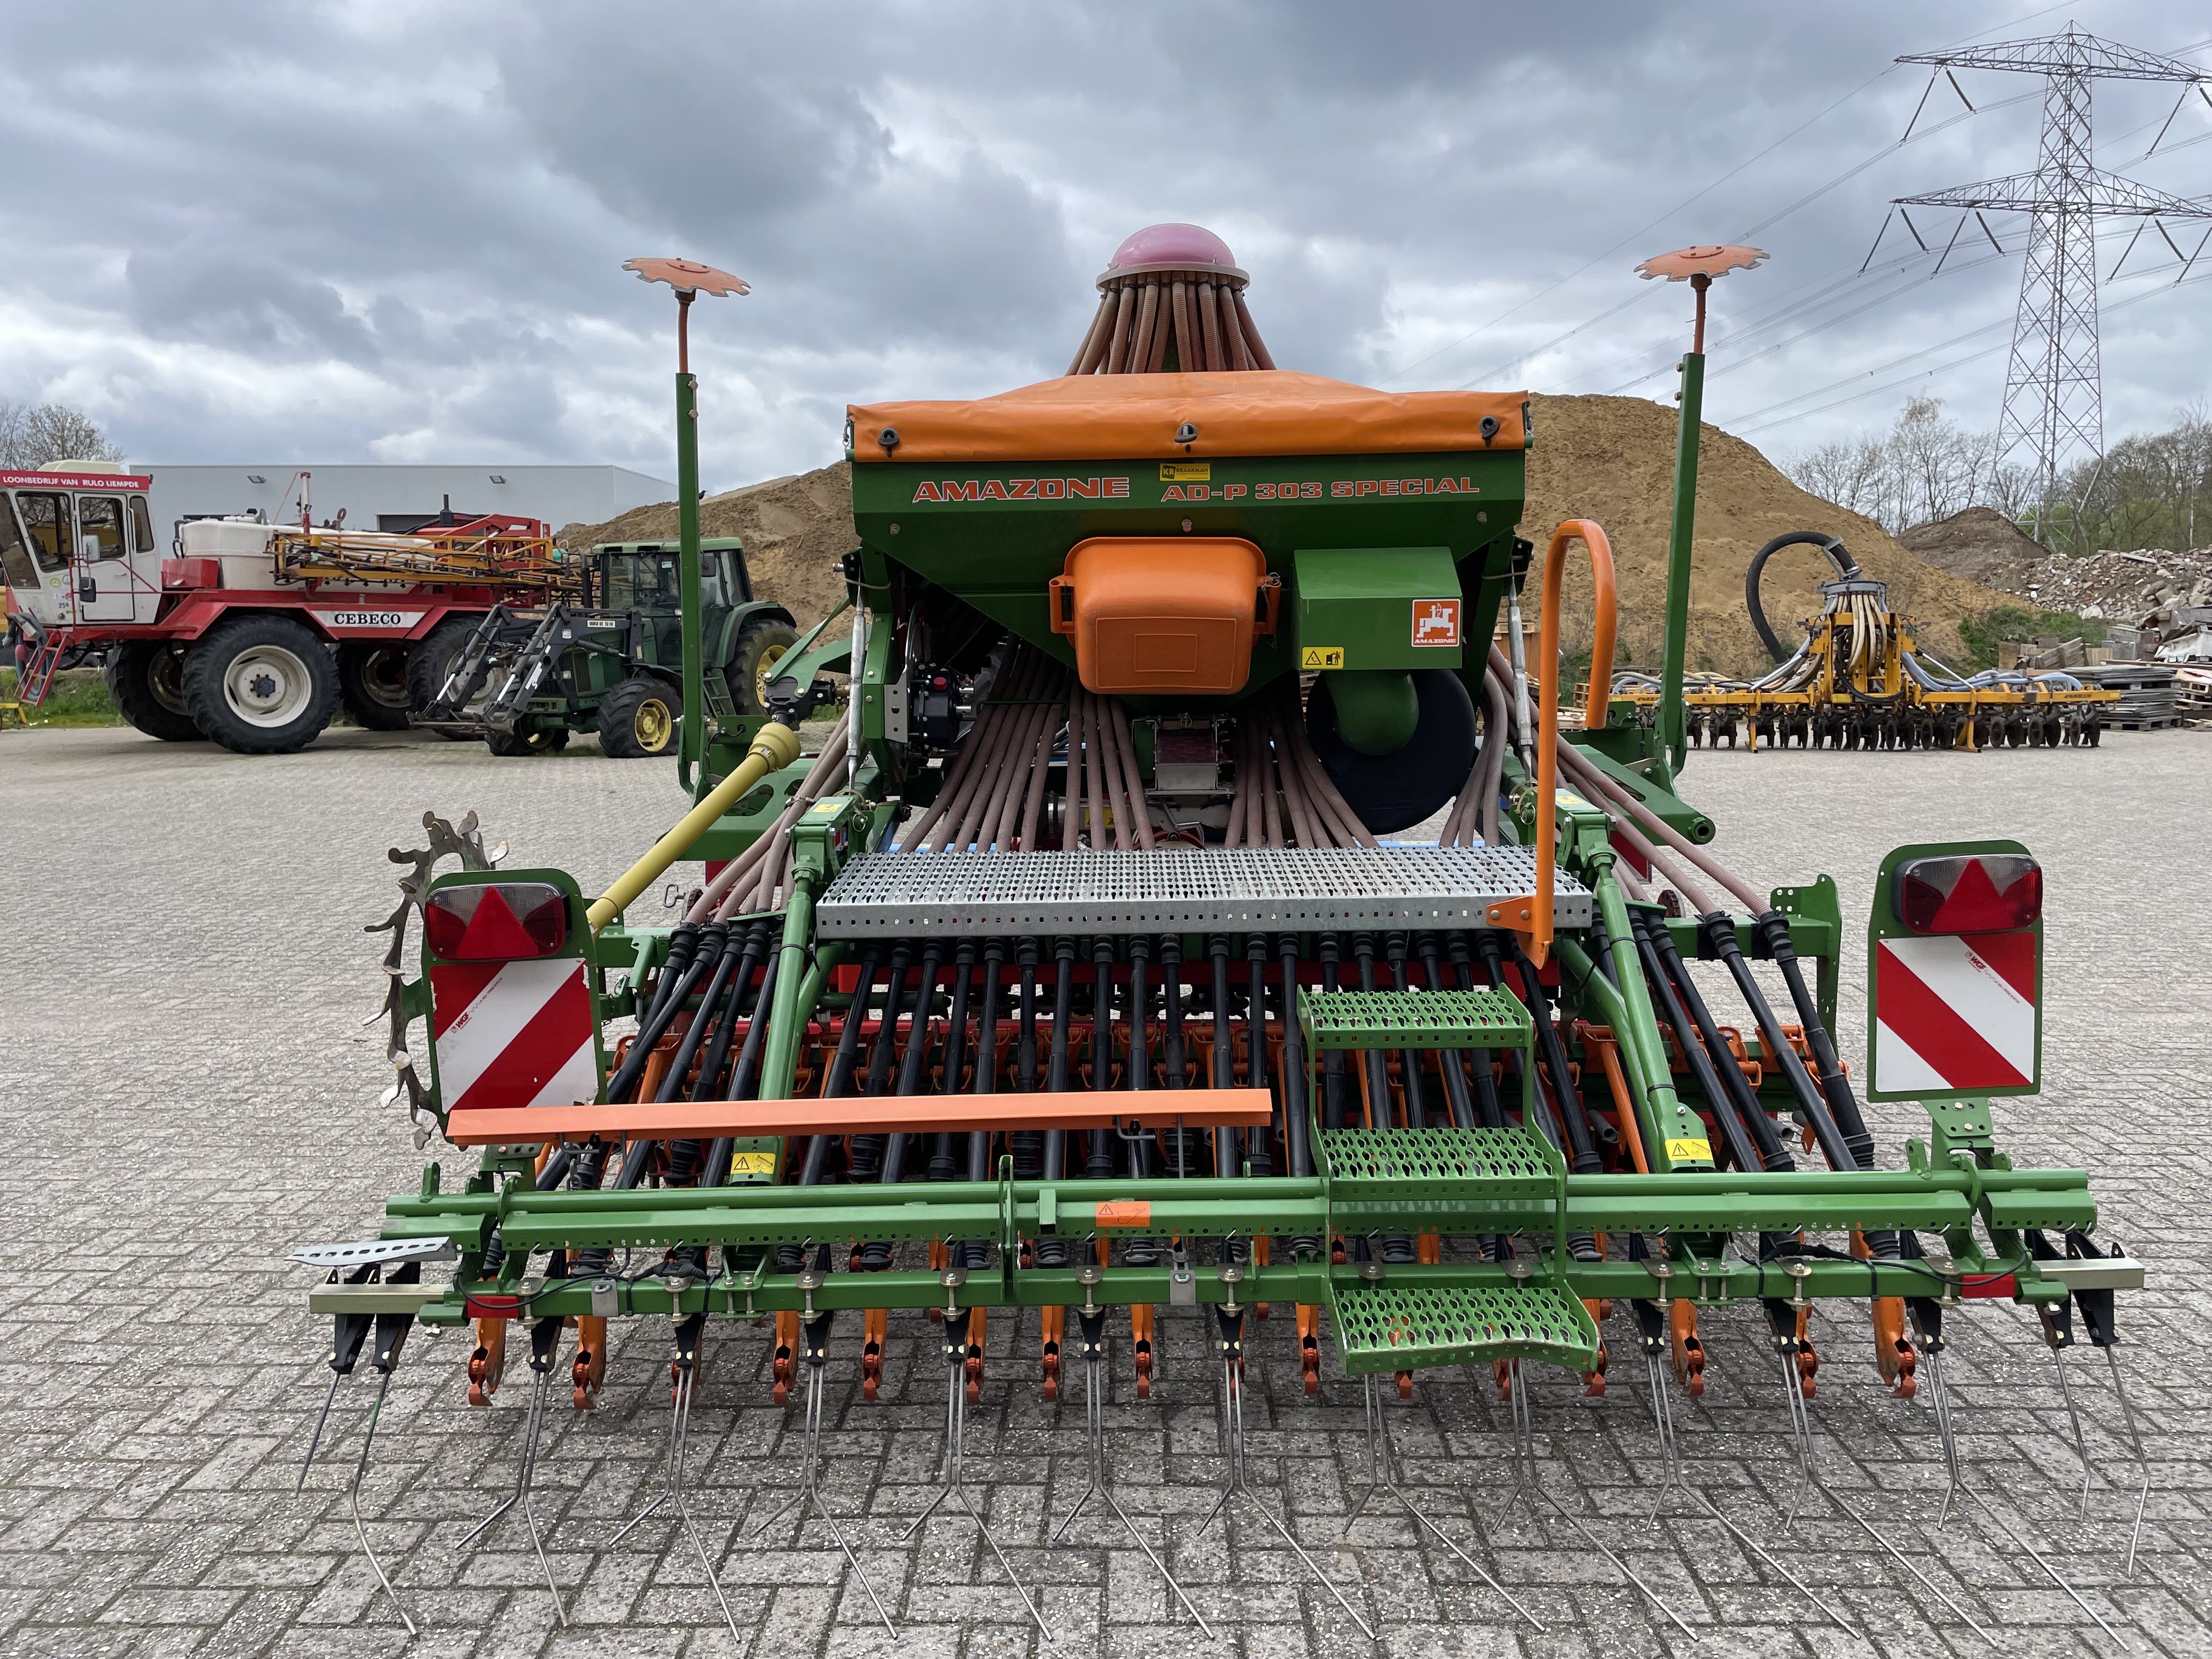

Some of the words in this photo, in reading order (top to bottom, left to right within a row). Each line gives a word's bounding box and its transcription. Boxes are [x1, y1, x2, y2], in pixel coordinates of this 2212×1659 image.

[3, 476, 59, 485] LOONBEDRIJF
[912, 477, 1129, 503] AMAZONE
[1160, 484, 1247, 503] AD-P
[1255, 482, 1322, 499] 303
[1331, 477, 1480, 498] SPECIAL
[334, 613, 401, 624] CEBECO
[1971, 956, 1986, 969] WGF
[455, 1012, 469, 1028] WGF
